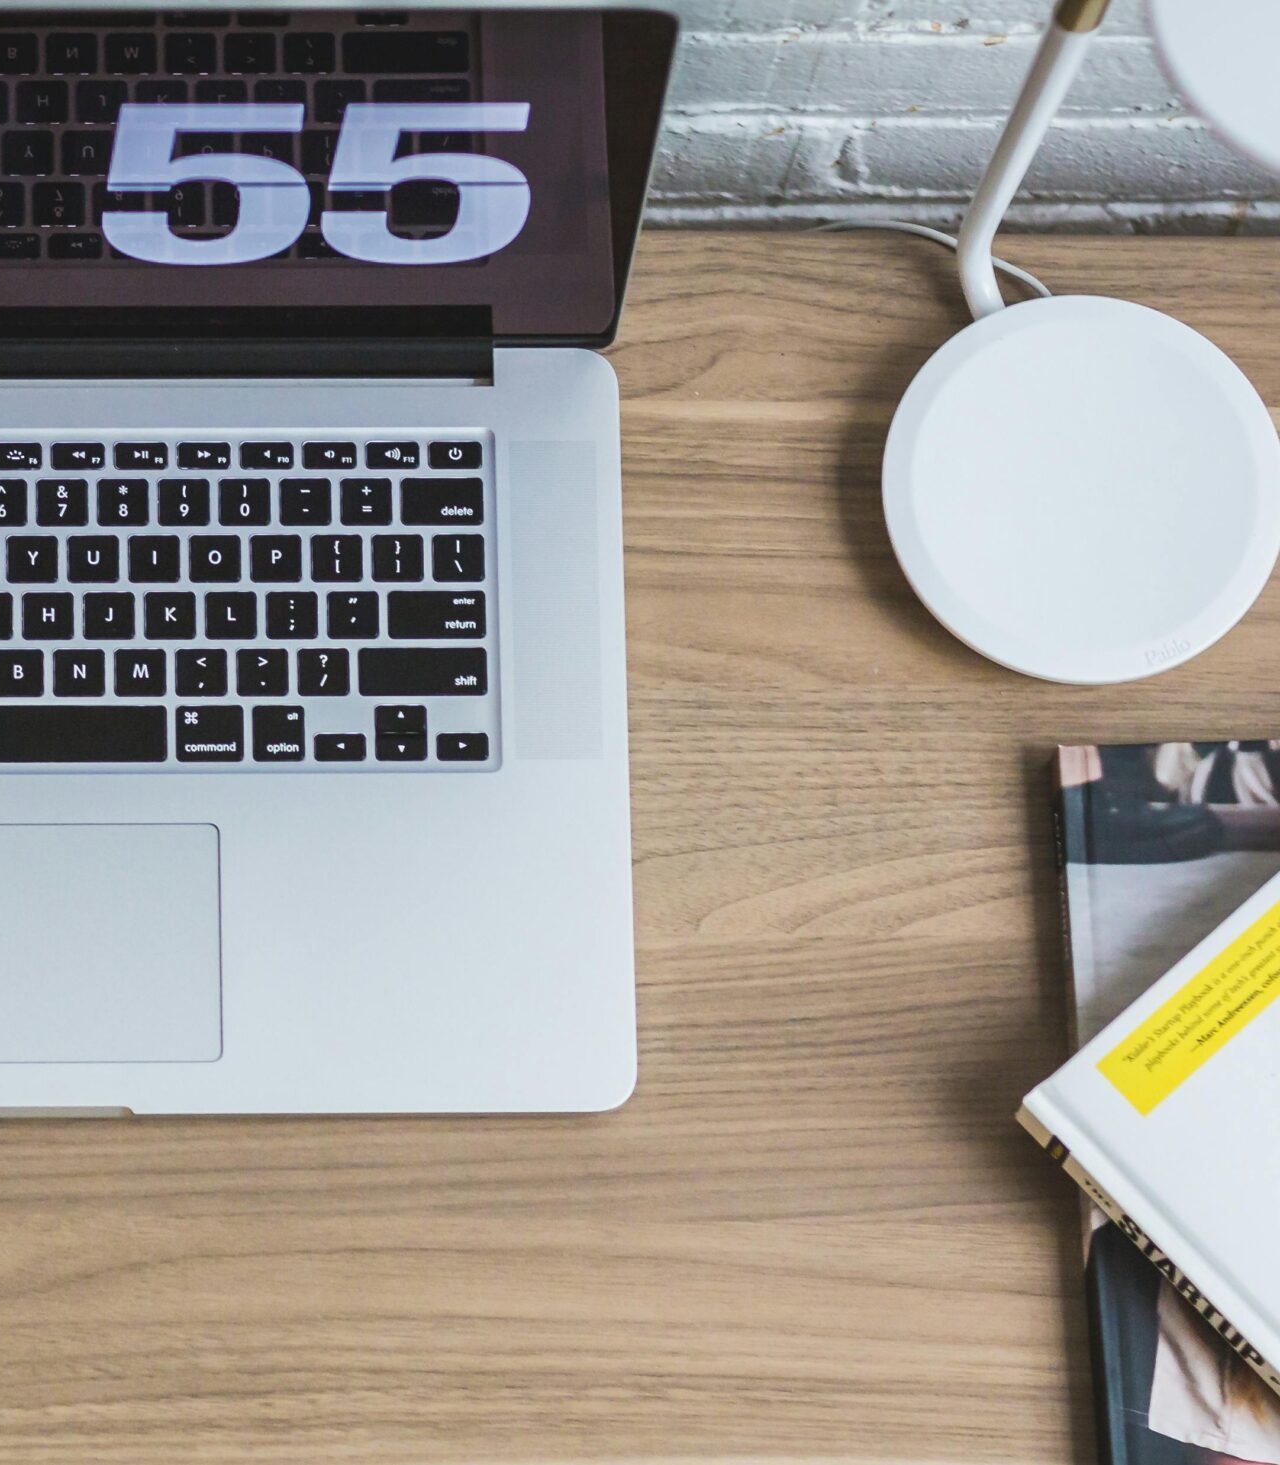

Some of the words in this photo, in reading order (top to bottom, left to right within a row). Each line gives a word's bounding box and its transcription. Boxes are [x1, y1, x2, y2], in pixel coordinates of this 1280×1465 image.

[103, 104, 531, 266] 55
[28, 457, 38, 465] F6
[91, 456, 101, 464] F7
[217, 456, 227, 464] F9
[277, 456, 290, 464] F10
[341, 456, 353, 464] F11
[56, 485, 69, 499] &
[182, 485, 187, 498] (
[242, 484, 247, 498] )
[361, 485, 372, 496] +
[57, 503, 68, 518] 7
[118, 503, 129, 518] 8
[179, 503, 190, 517] 9
[239, 502, 251, 517] 0
[361, 505, 373, 513] =
[440, 505, 474, 517] delete
[27, 550, 39, 566] Y
[87, 550, 100, 565] U
[208, 549, 222, 565] O
[271, 549, 283, 565] P
[42, 607, 56, 623] H
[104, 607, 114, 622] J
[165, 606, 177, 622] K
[226, 606, 237, 622] L
[452, 597, 476, 605] enter
[444, 619, 477, 630] return
[196, 657, 207, 668] <
[257, 656, 269, 667] >
[319, 654, 329, 668] ?
[1144, 639, 1191, 667] Pablo
[13, 664, 24, 680] B
[73, 663, 87, 679] N
[132, 663, 150, 679] M
[454, 675, 478, 686] shift
[286, 712, 299, 721] alt
[184, 741, 237, 753] command
[266, 742, 300, 755] option
[1153, 1011, 1183, 1040] Startup
[1179, 983, 1214, 1016] Playbook
[1116, 1214, 1266, 1367] STARTUP
